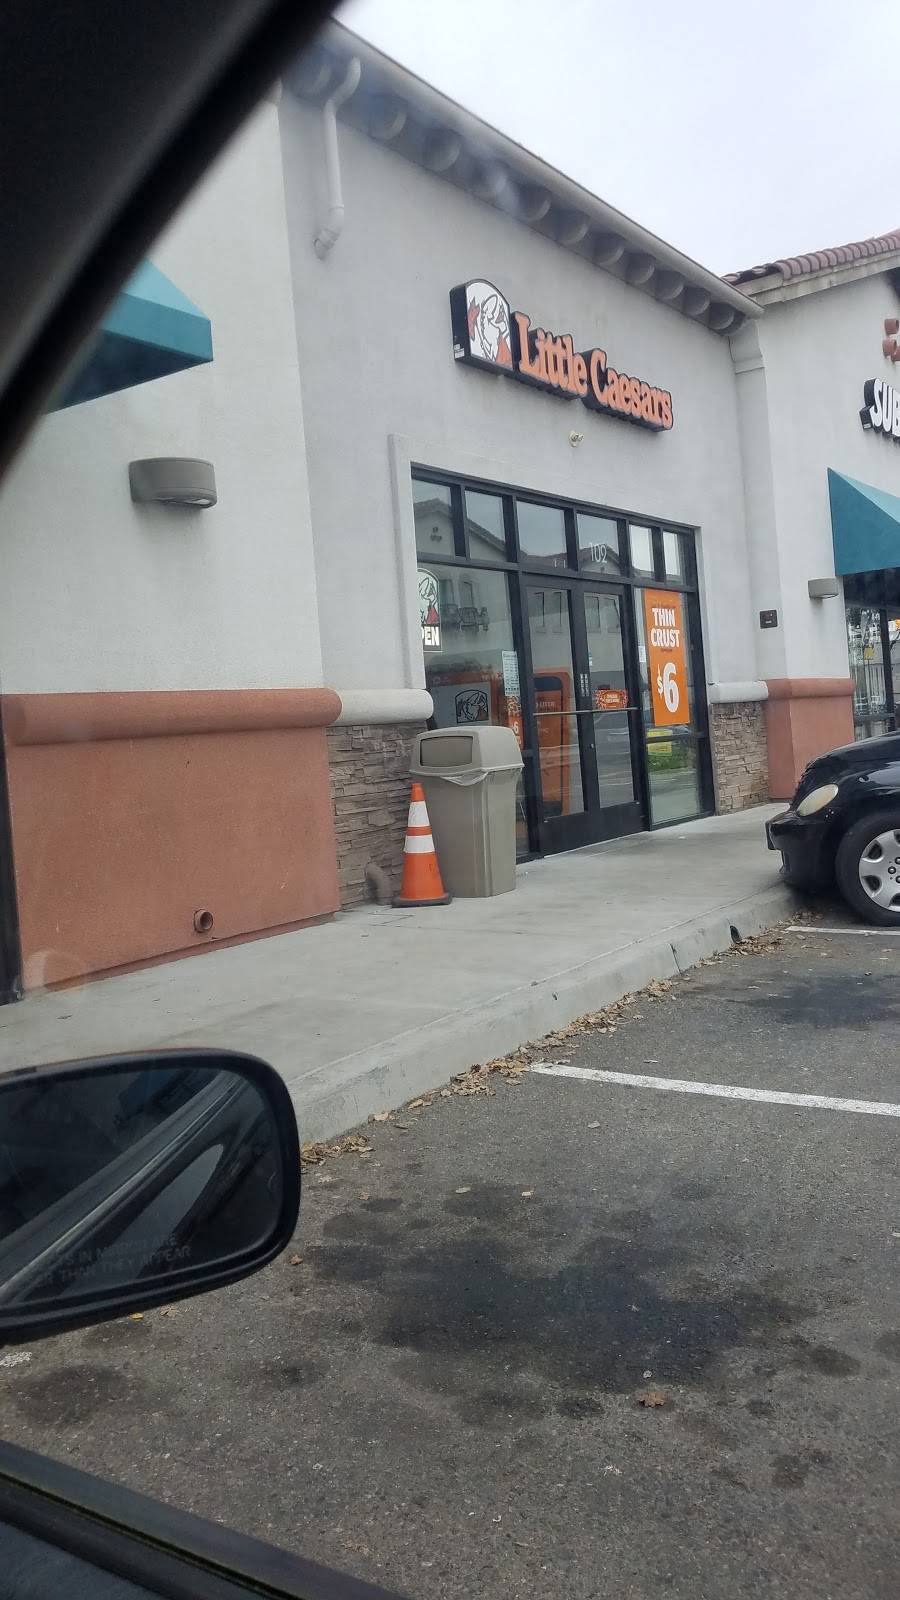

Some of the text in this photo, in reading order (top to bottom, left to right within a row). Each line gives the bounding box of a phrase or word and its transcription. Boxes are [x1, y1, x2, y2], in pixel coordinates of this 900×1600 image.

[514, 310, 675, 432] Little Caesars
[588, 541, 608, 564] 102
[651, 607, 676, 627] THIN
[650, 627, 681, 648] CRUST
[656, 662, 680, 712] $6
